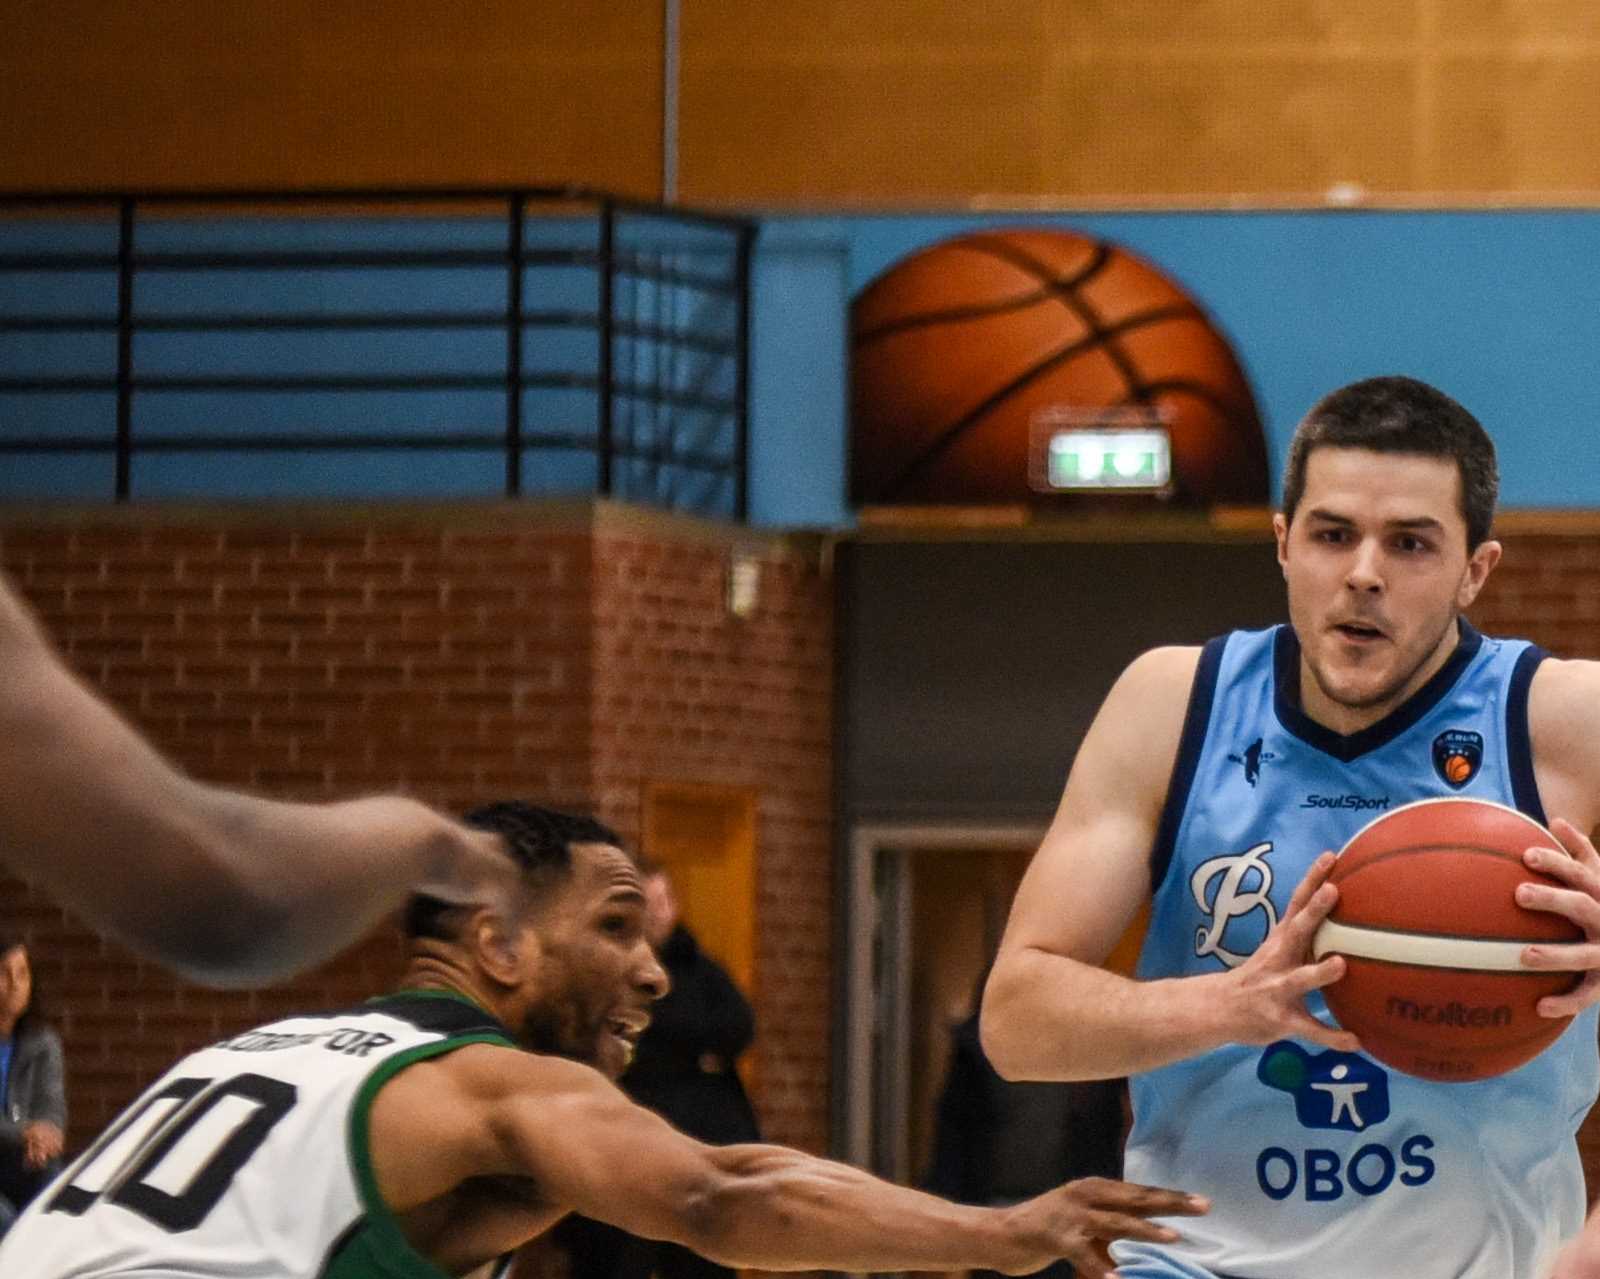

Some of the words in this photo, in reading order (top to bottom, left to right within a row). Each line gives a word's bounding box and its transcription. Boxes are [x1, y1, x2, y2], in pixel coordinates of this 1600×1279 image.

[1301, 794, 1390, 811] SoulSport
[1386, 997, 1512, 1028] molten
[1256, 1134, 1436, 1202] OBOS
